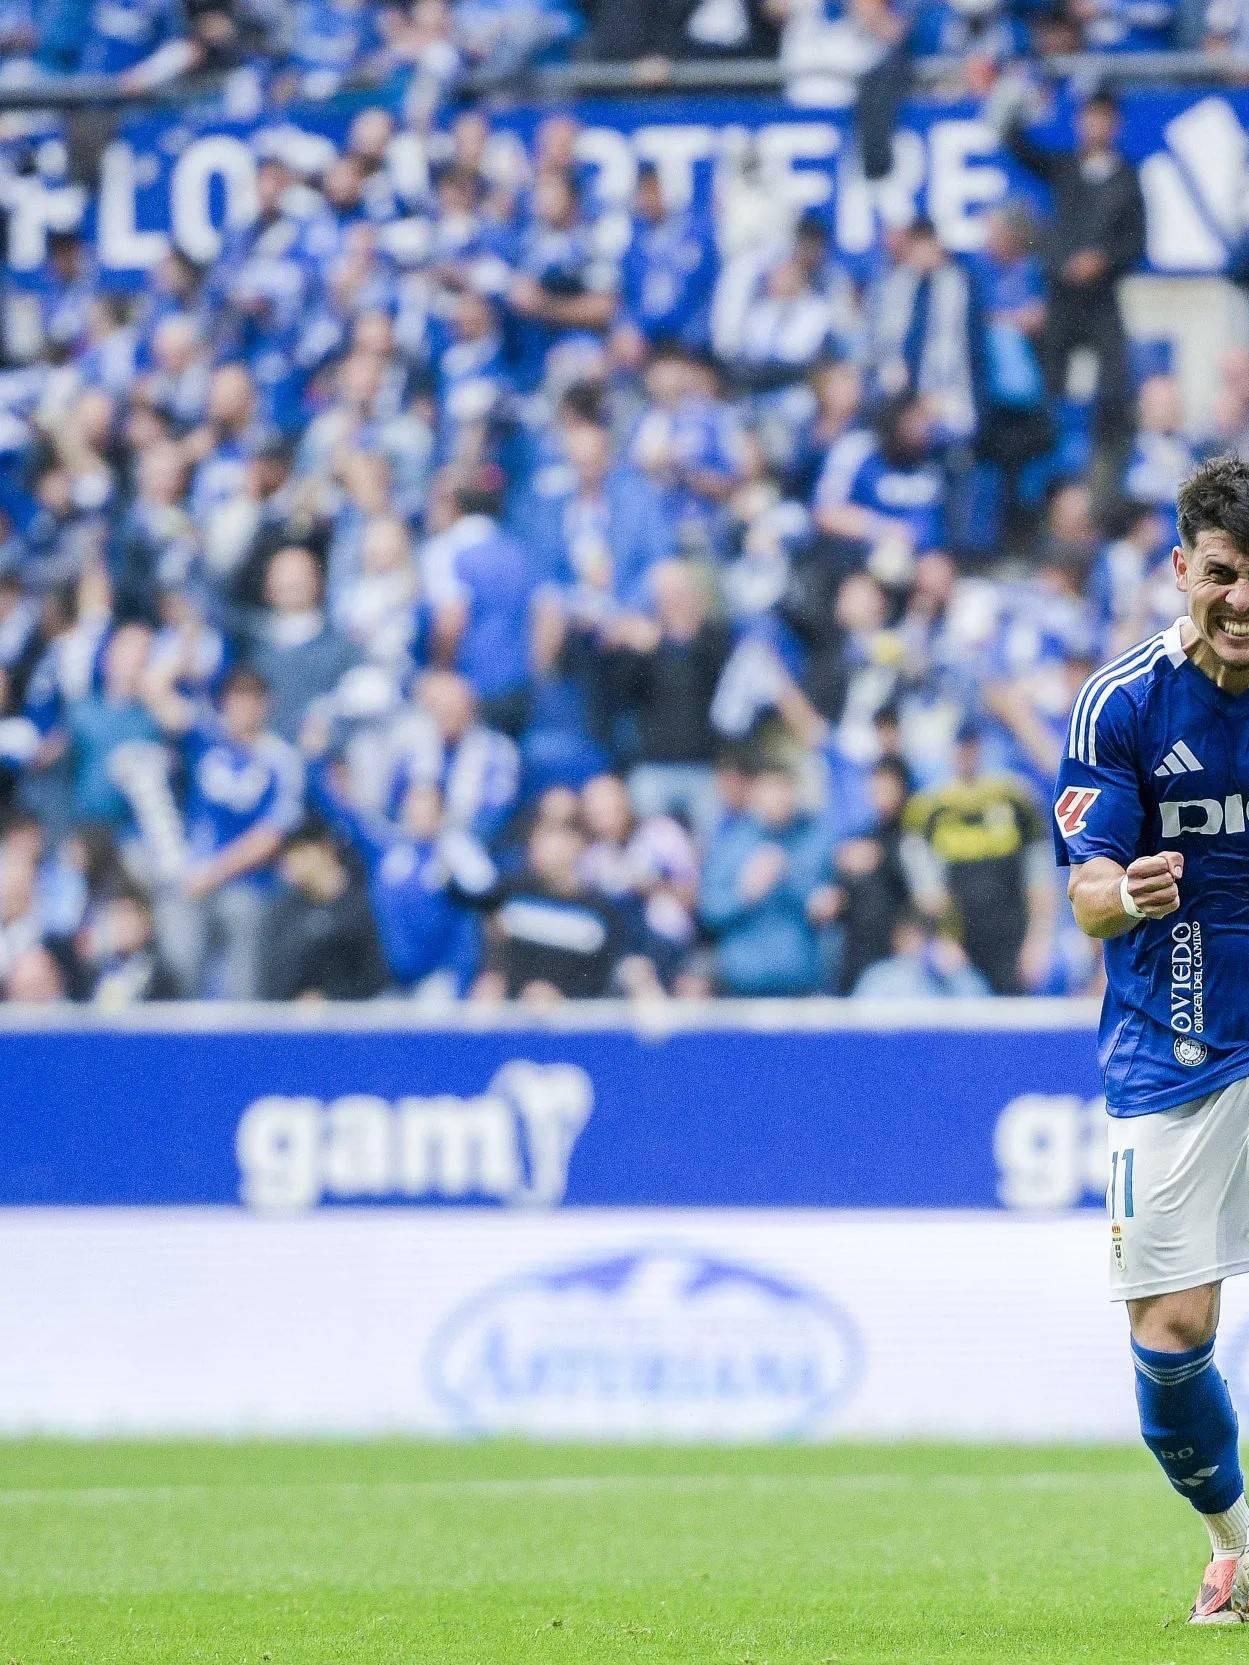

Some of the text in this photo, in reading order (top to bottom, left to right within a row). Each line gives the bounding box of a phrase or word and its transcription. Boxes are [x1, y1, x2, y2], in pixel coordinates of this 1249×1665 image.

[1171, 922, 1191, 1033] OVIEDO
[1192, 921, 1204, 1033] ORIGEN DEL CAMINO
[1111, 1148, 1134, 1219] 11
